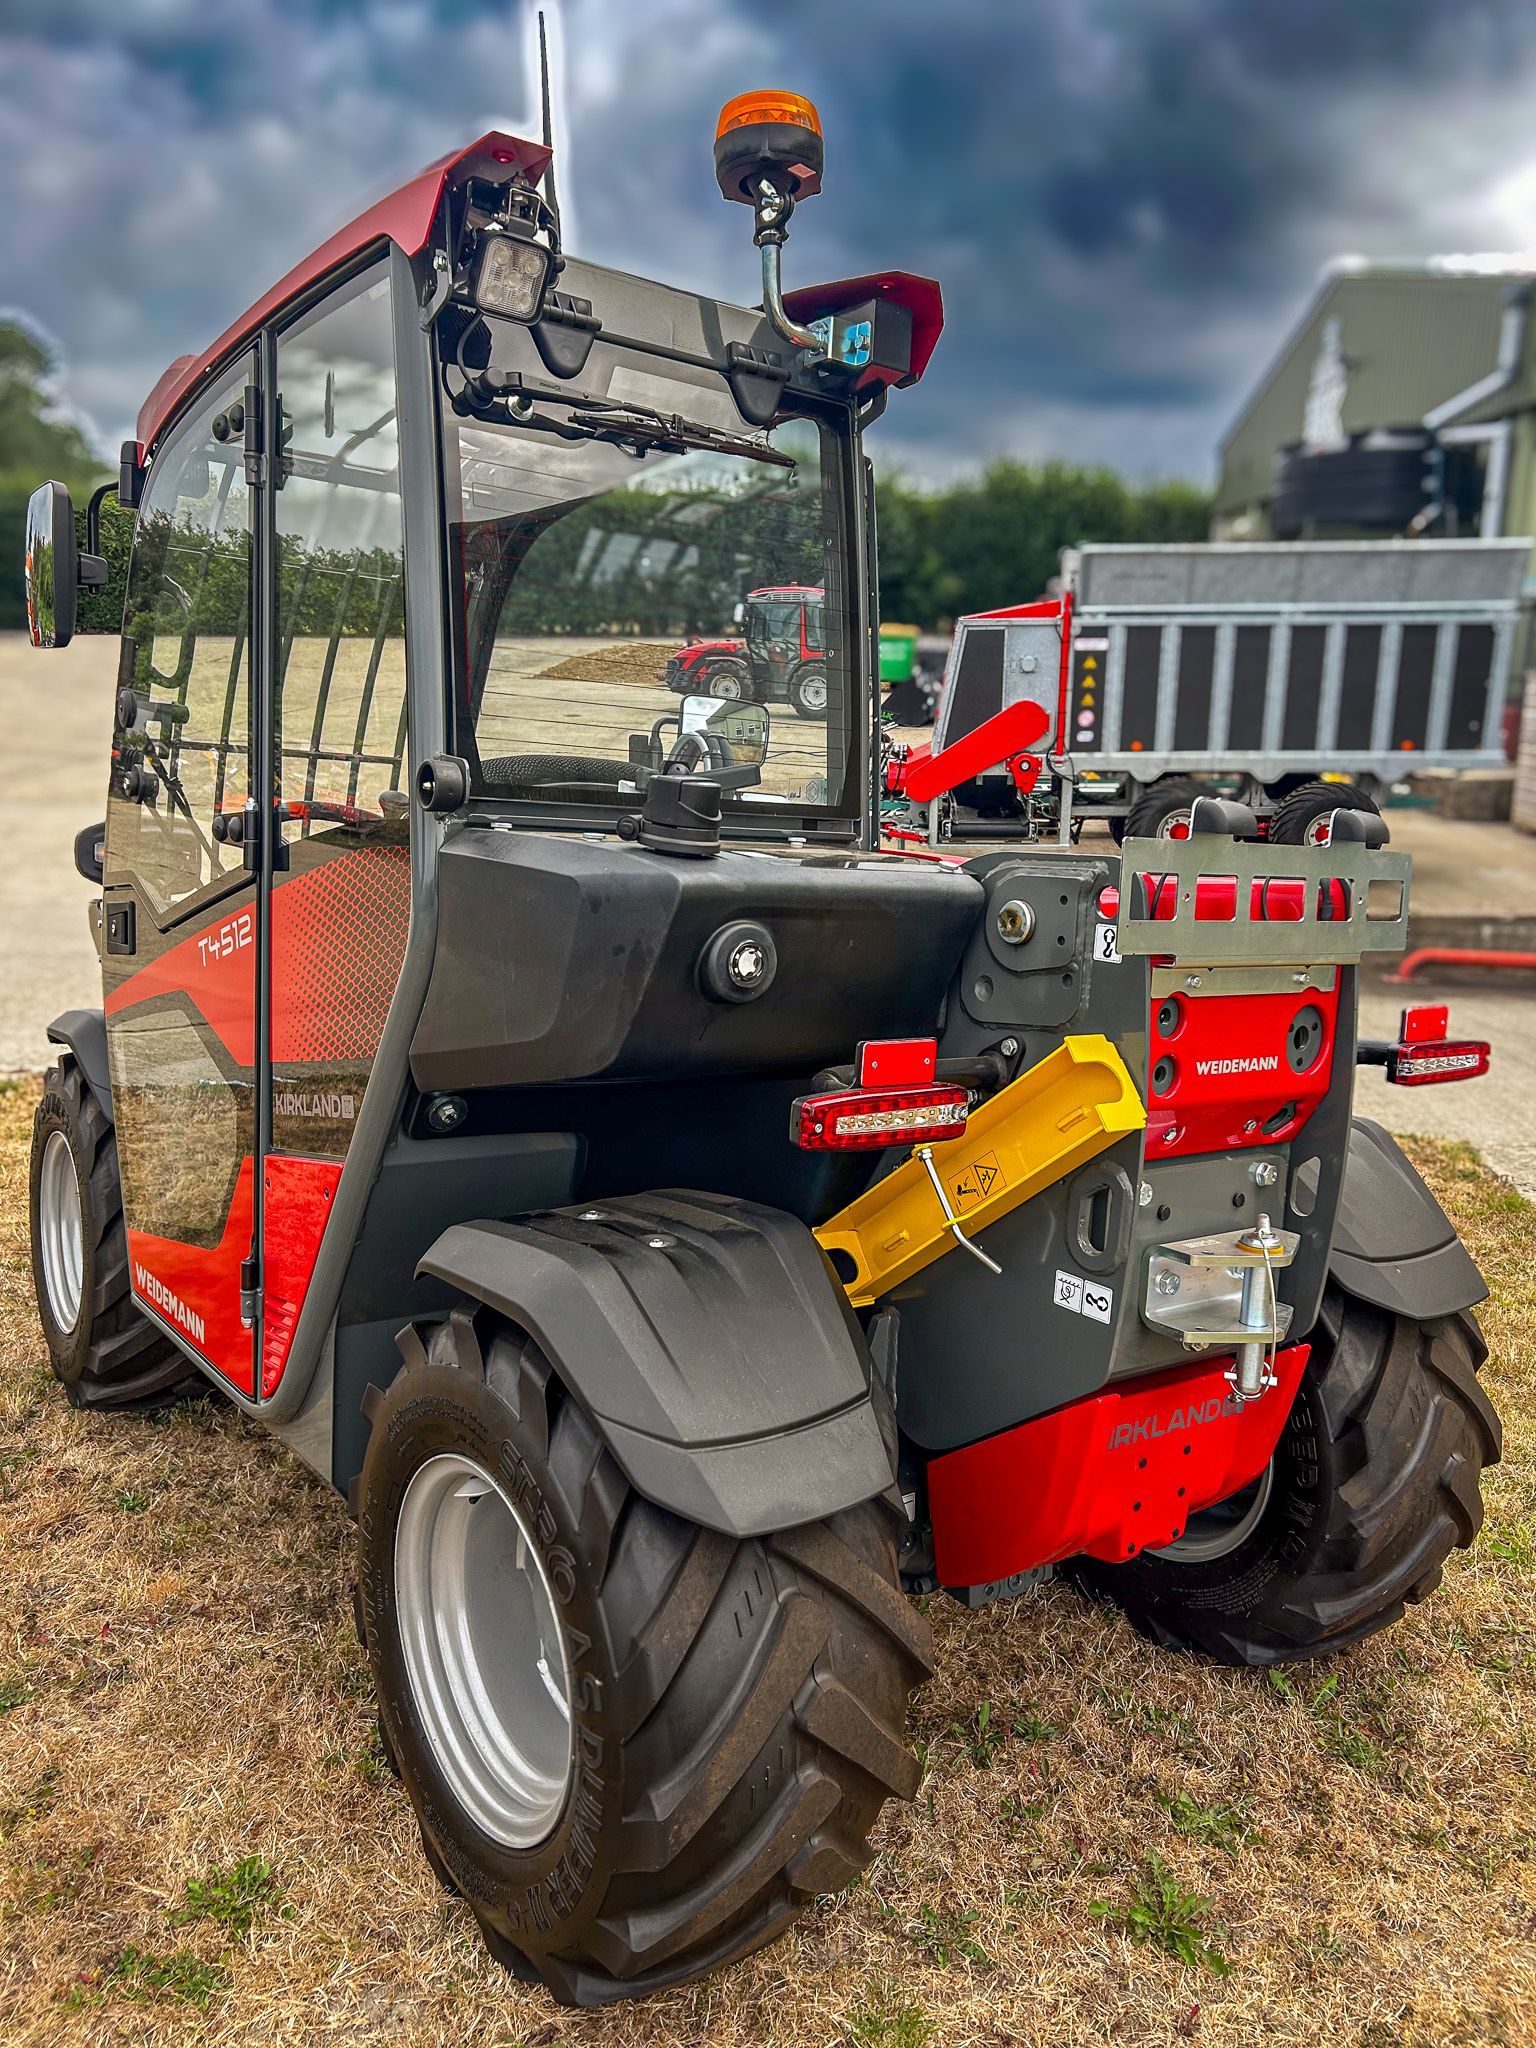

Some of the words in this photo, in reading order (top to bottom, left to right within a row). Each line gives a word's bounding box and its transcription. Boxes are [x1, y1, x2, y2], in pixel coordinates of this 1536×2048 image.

[197, 913, 254, 967] T4512
[1196, 1055, 1279, 1076] WEIDEMANN
[275, 1093, 341, 1118] KIRKLAND
[135, 1260, 205, 1345] WEIDEMANN
[1107, 1399, 1221, 1450] IRKLAND
